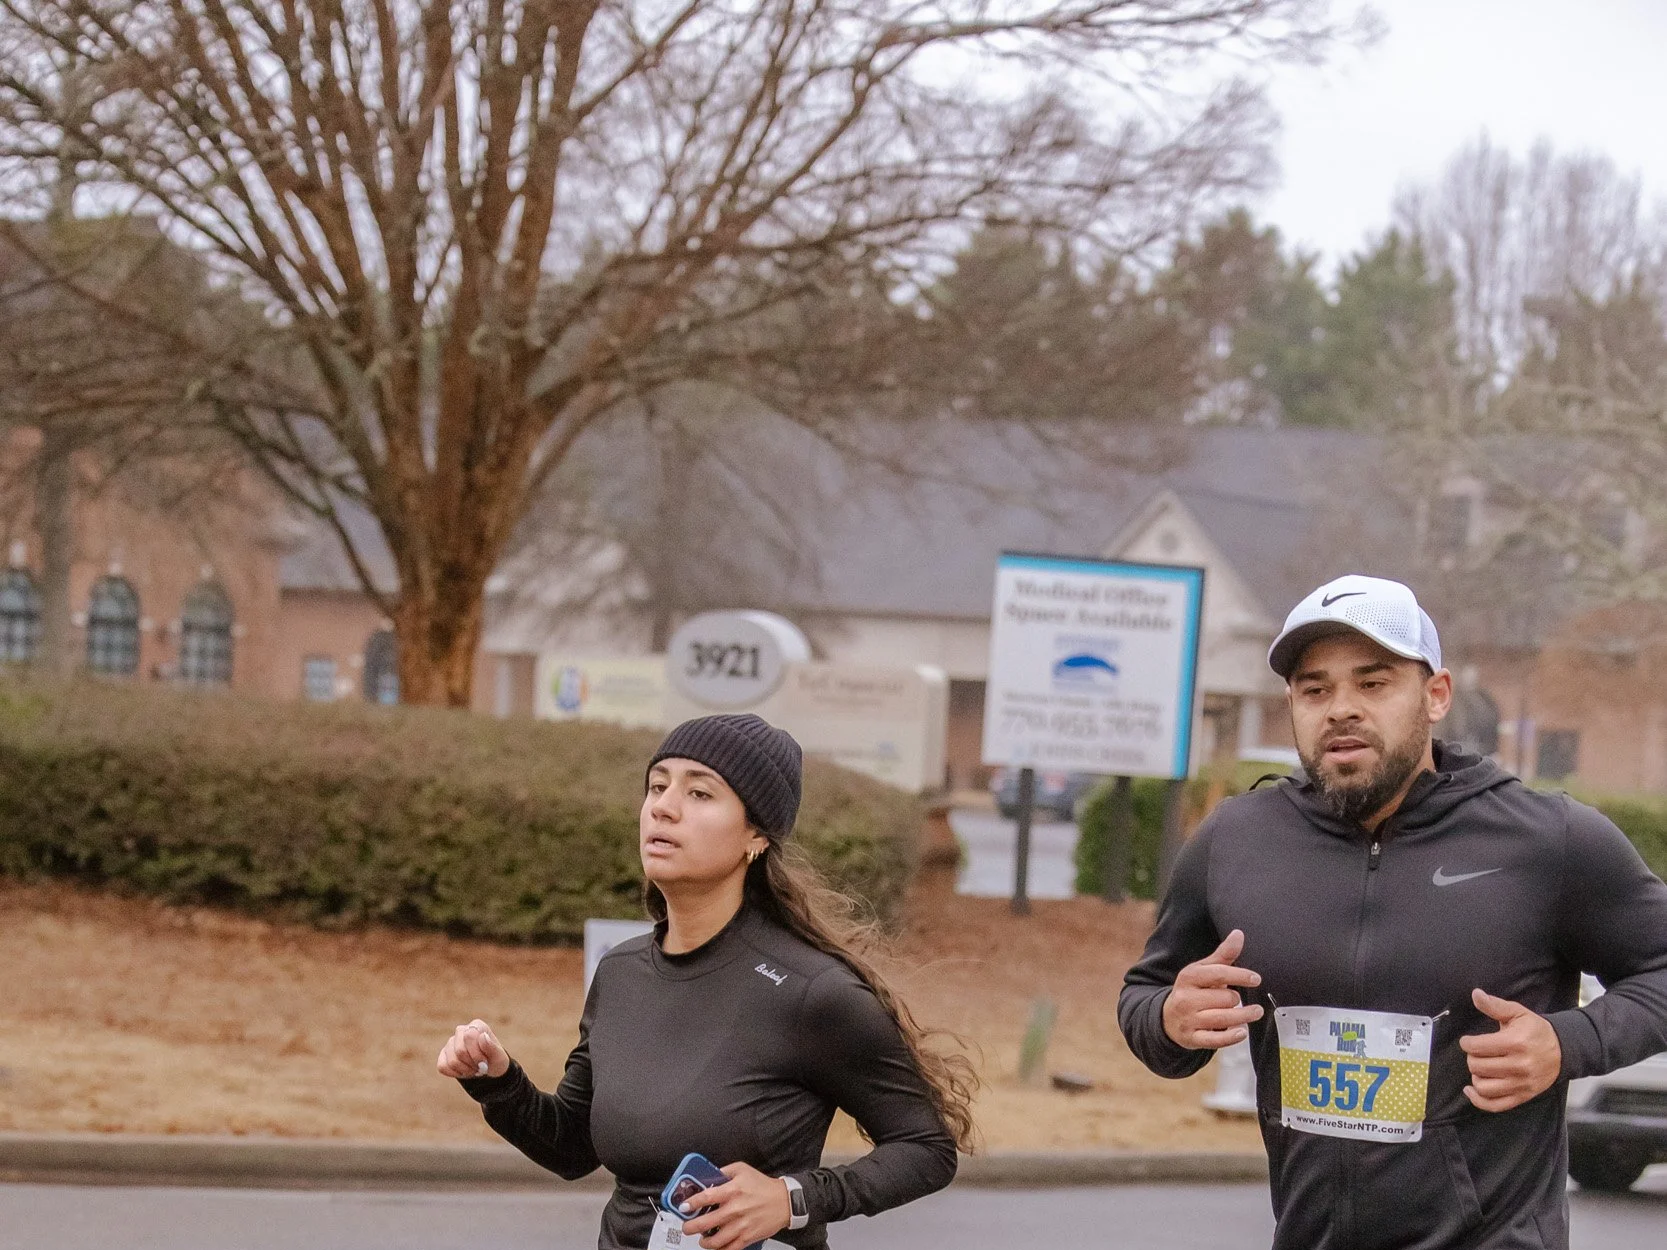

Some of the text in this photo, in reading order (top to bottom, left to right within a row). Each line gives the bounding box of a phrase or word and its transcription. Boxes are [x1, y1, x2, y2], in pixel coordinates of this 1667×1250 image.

[685, 640, 762, 681] 3921
[1308, 1059, 1391, 1113] 557
[1296, 1115, 1404, 1135] www.FiveStarNTP.com
